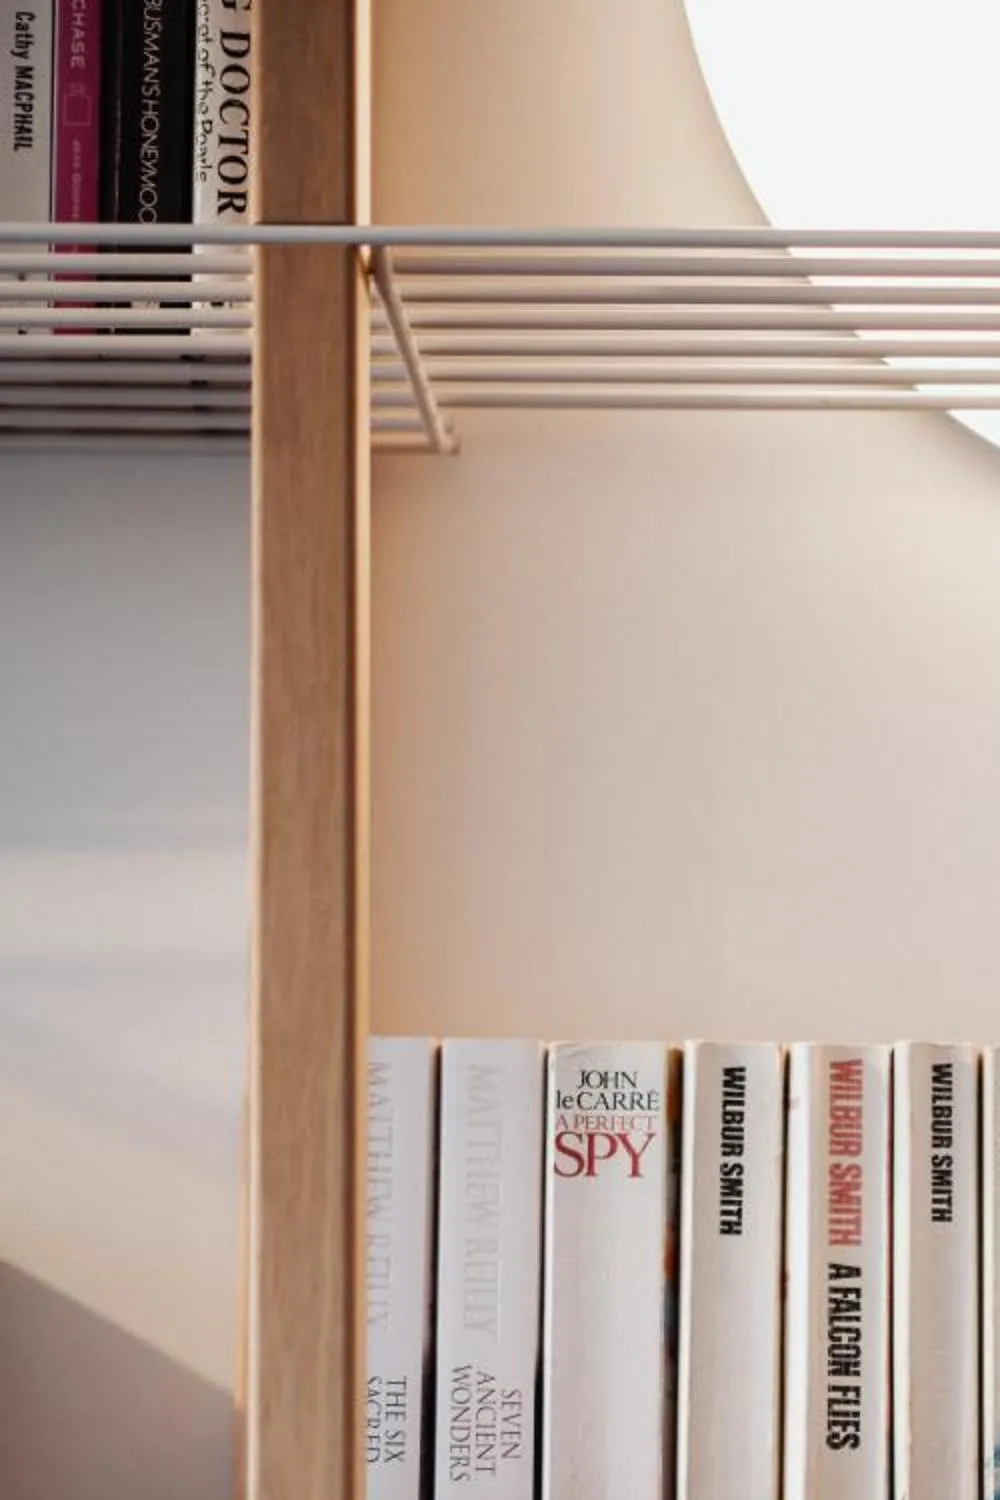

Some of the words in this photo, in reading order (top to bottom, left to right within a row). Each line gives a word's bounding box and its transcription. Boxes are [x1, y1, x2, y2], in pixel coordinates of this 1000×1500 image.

[10, 11, 36, 60] Cathy
[70, 0, 87, 69] CHASE
[197, 49, 216, 79] of
[13, 65, 36, 152] MACPHAIL
[198, 80, 214, 116] the
[217, 29, 250, 216] DOCTOR
[138, 98, 161, 223] HONEYMOO
[577, 1070, 638, 1089] JOHN
[719, 1065, 746, 1158] WILBUR
[829, 1058, 863, 1158] WILBUR
[931, 1062, 953, 1149] WILBUR
[554, 1131, 656, 1178] SPY
[555, 1114, 569, 1131] A
[573, 1114, 658, 1131] PERFECT
[719, 1163, 745, 1236] SMITH
[828, 1162, 863, 1246] SMITH
[931, 1154, 953, 1223] SMITH
[828, 1263, 862, 1280] A
[827, 1287, 862, 1377] FALCON
[385, 1376, 407, 1421] THE
[449, 1364, 474, 1483] WONDERS
[476, 1369, 497, 1477] ANCIENT
[499, 1388, 523, 1461] SEVEN
[826, 1384, 861, 1451] FLIES
[384, 1429, 407, 1464] SIX
